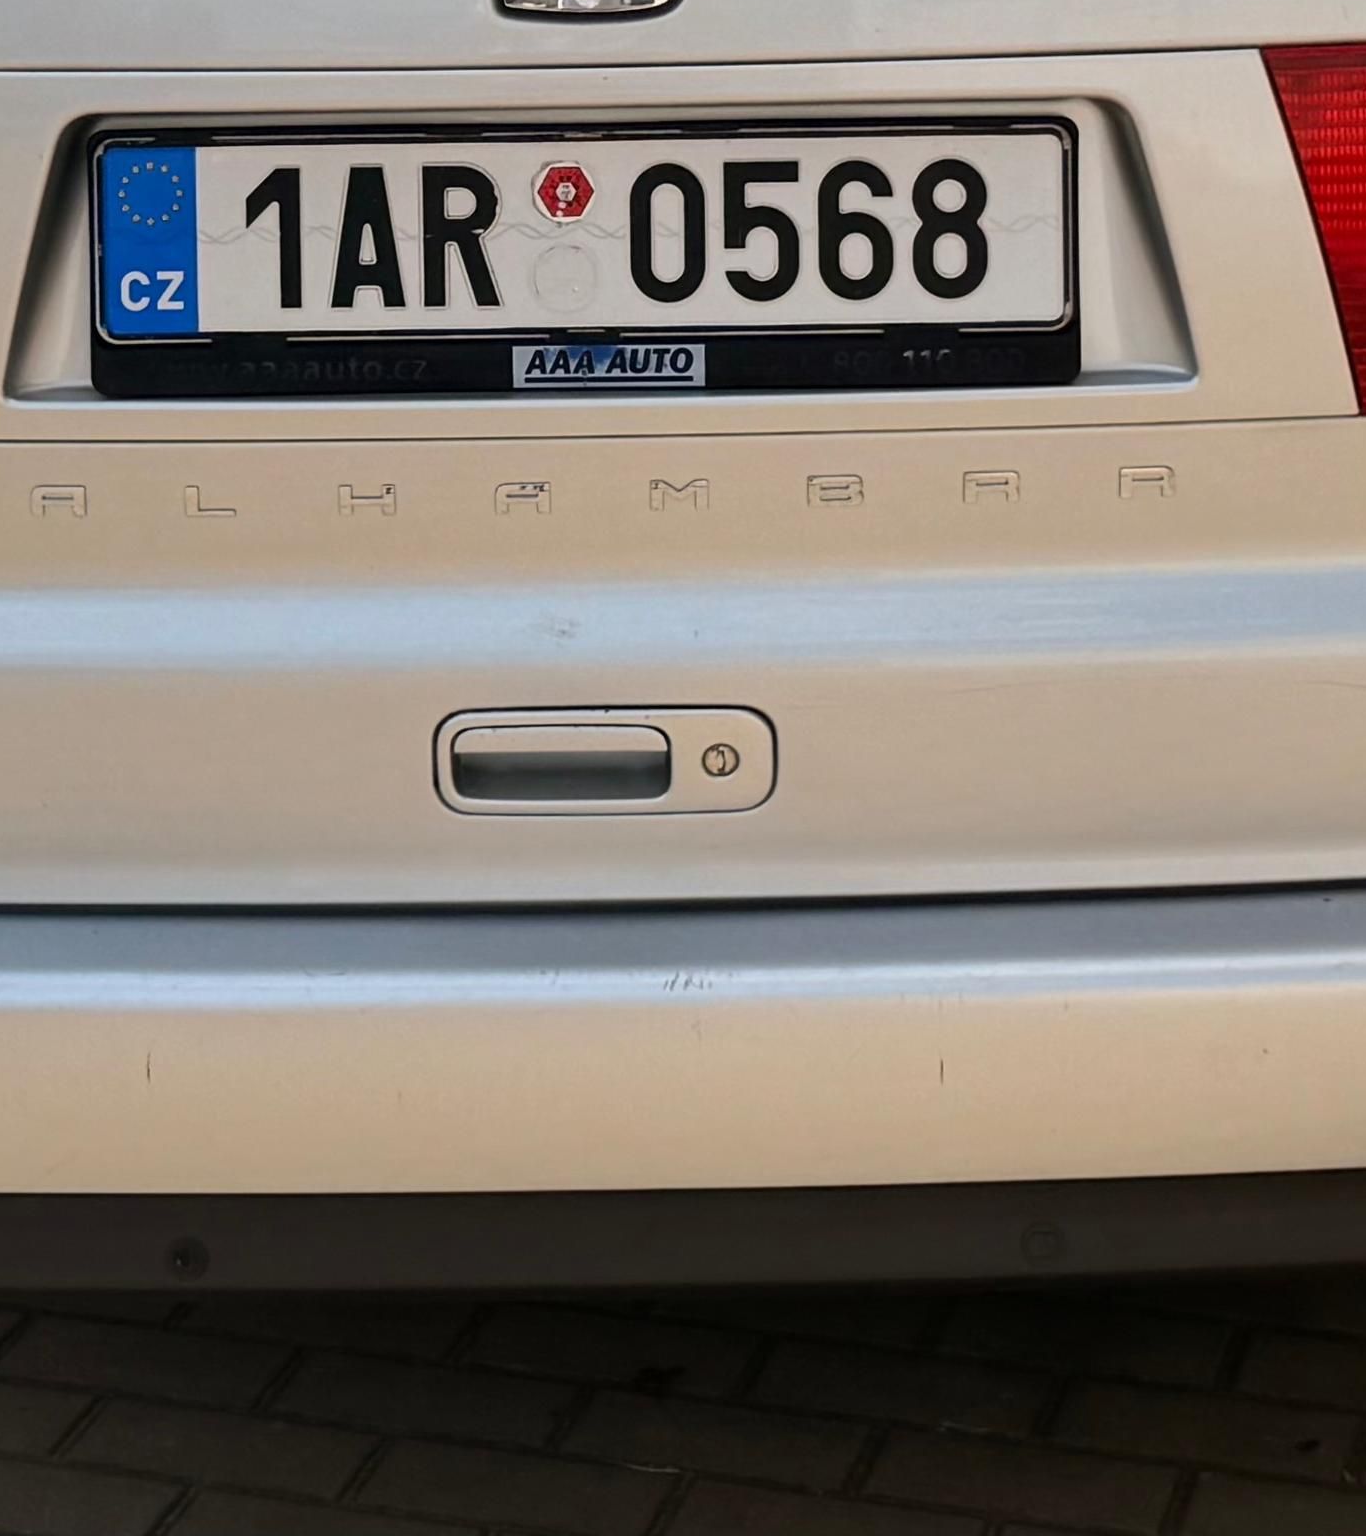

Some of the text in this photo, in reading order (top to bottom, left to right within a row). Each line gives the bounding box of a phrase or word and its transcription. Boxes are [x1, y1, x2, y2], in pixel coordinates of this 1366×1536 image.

[245, 158, 989, 309] 1AR 0568
[119, 270, 186, 311] CZ
[524, 347, 694, 375] AAA AUTO
[31, 465, 1176, 518] ALHAMBRA
